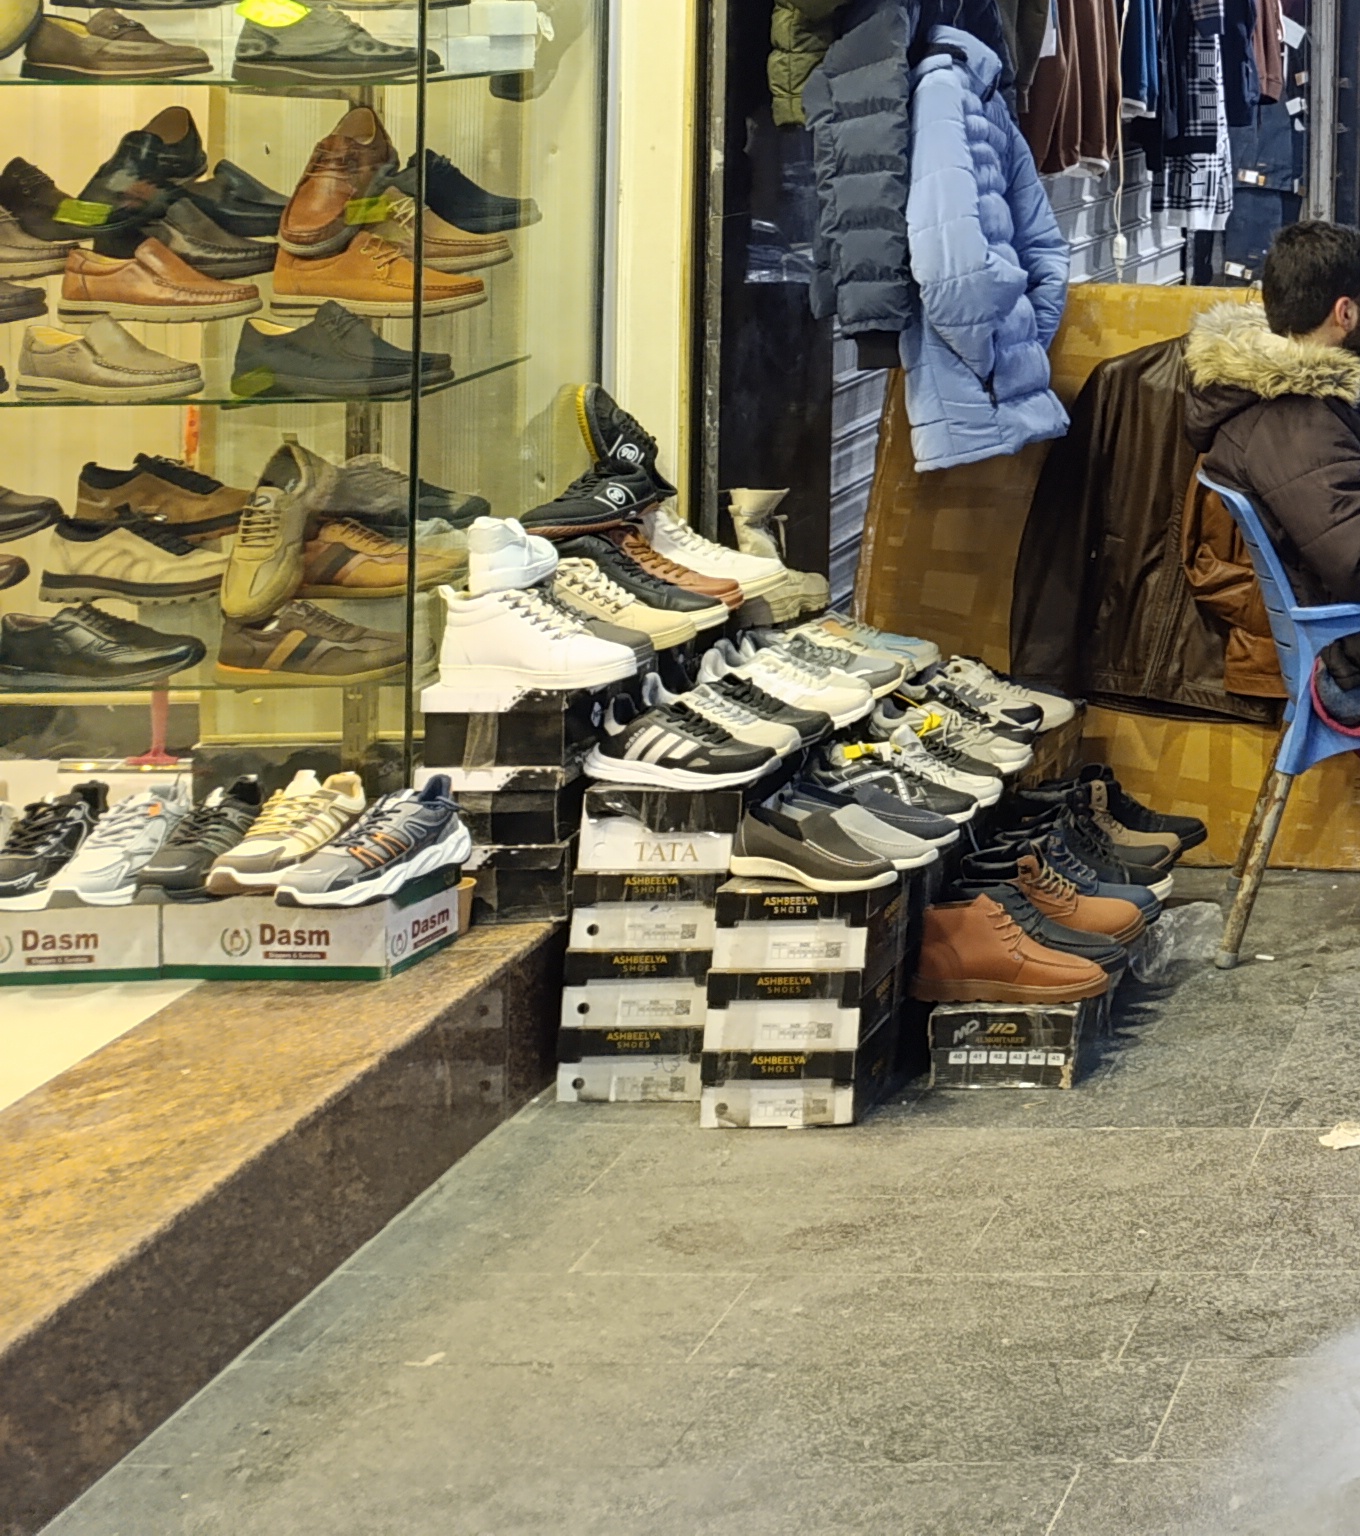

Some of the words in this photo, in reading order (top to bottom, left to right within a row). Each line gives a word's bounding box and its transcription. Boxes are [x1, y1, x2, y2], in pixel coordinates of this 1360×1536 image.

[634, 842, 699, 862] TATA
[625, 876, 679, 885] ASHBEELYA
[764, 896, 819, 906] ASHBEELYA
[773, 906, 808, 914] SHOES
[411, 908, 450, 938] Dasm
[259, 924, 331, 946] Dasm
[21, 929, 99, 952] Dasm
[613, 955, 668, 964] ASHBEELYA
[757, 977, 812, 986] ASHBEELYA
[606, 1031, 661, 1041] ASHBEELYA
[752, 1056, 806, 1065] ASHBEELYA
[761, 1065, 795, 1073] SHOES
